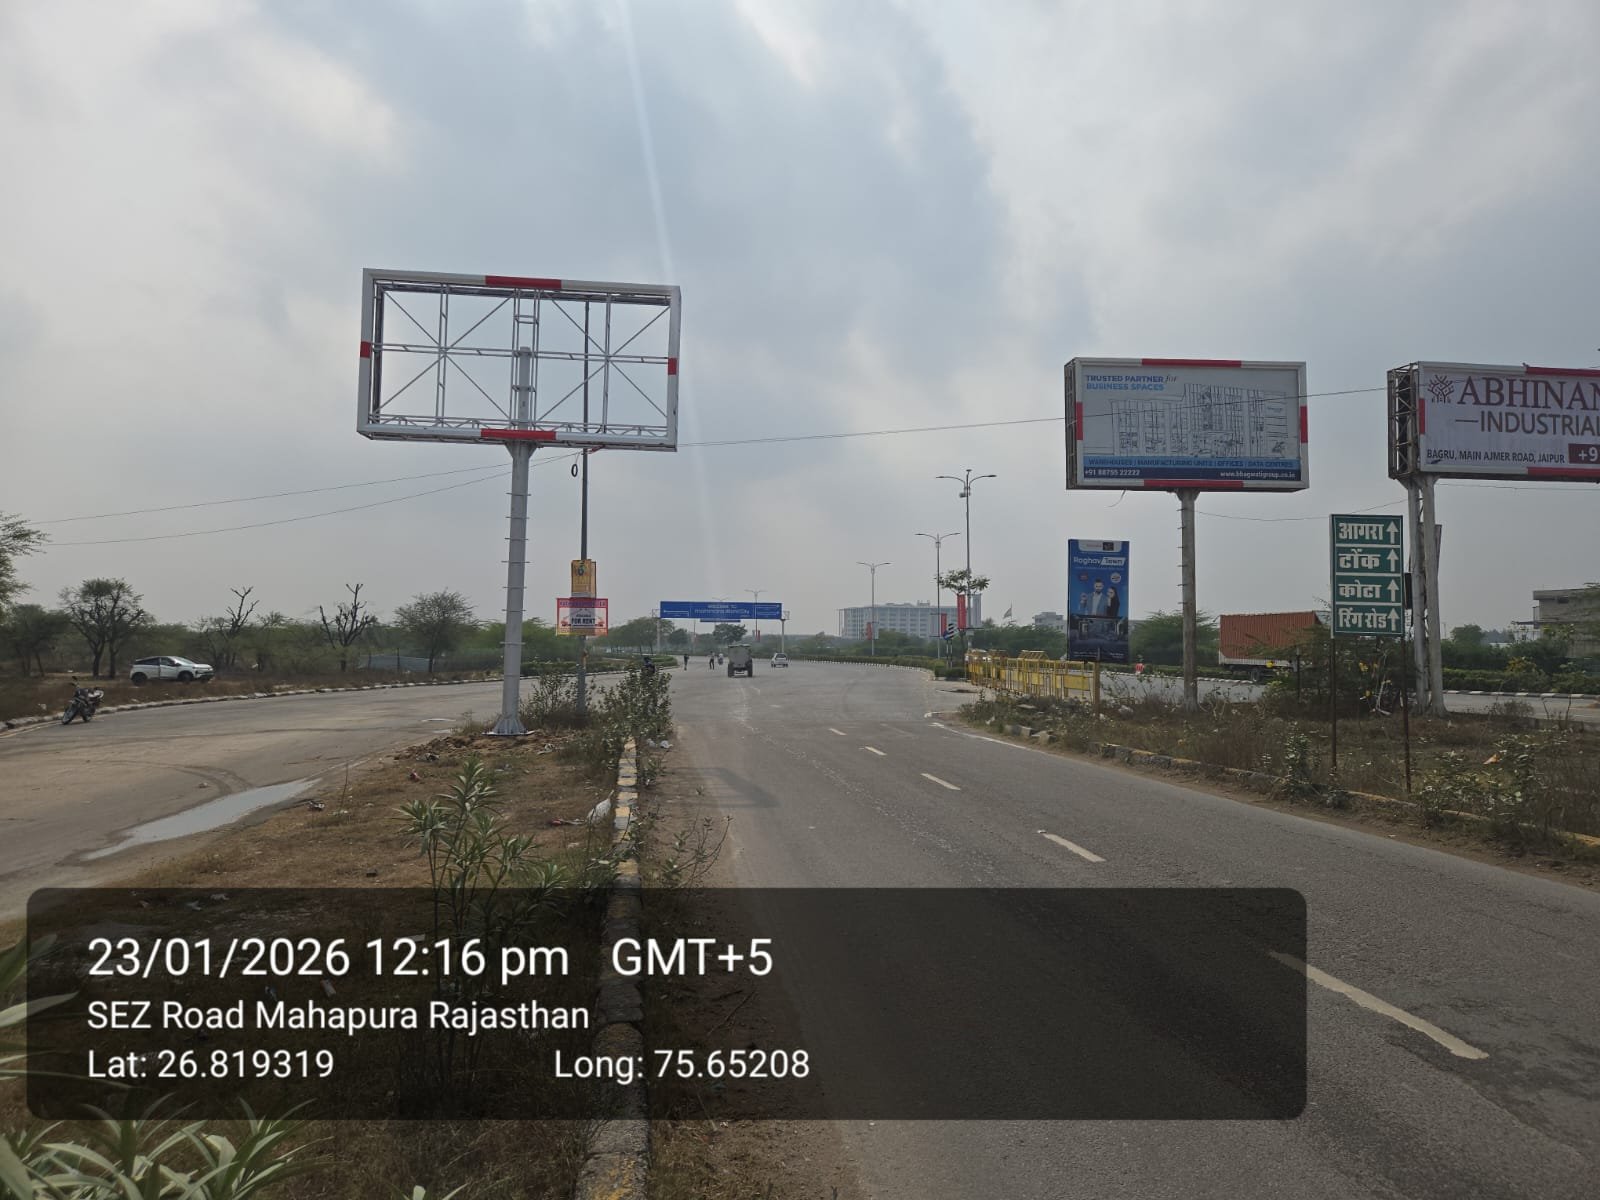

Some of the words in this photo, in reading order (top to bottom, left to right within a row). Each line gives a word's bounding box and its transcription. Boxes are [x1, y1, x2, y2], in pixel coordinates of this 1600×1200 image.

[1086, 375, 1123, 383] TRUSTED
[1125, 375, 1163, 384] PARTNER
[1086, 383, 1129, 391] BUSINESS
[1131, 383, 1164, 391] SPACES
[1427, 449, 1457, 460] BAGRU,
[1459, 450, 1482, 461] MAIN
[1484, 451, 1510, 462] AJMER
[1512, 452, 1536, 463] ROAD,
[1538, 453, 1565, 464] JAIPUR
[1338, 522, 1384, 541] आगरा
[1338, 548, 1381, 570] टोंक
[1338, 579, 1382, 599] कोटा
[1338, 607, 1363, 628] रिंग
[1364, 608, 1387, 629] रोड
